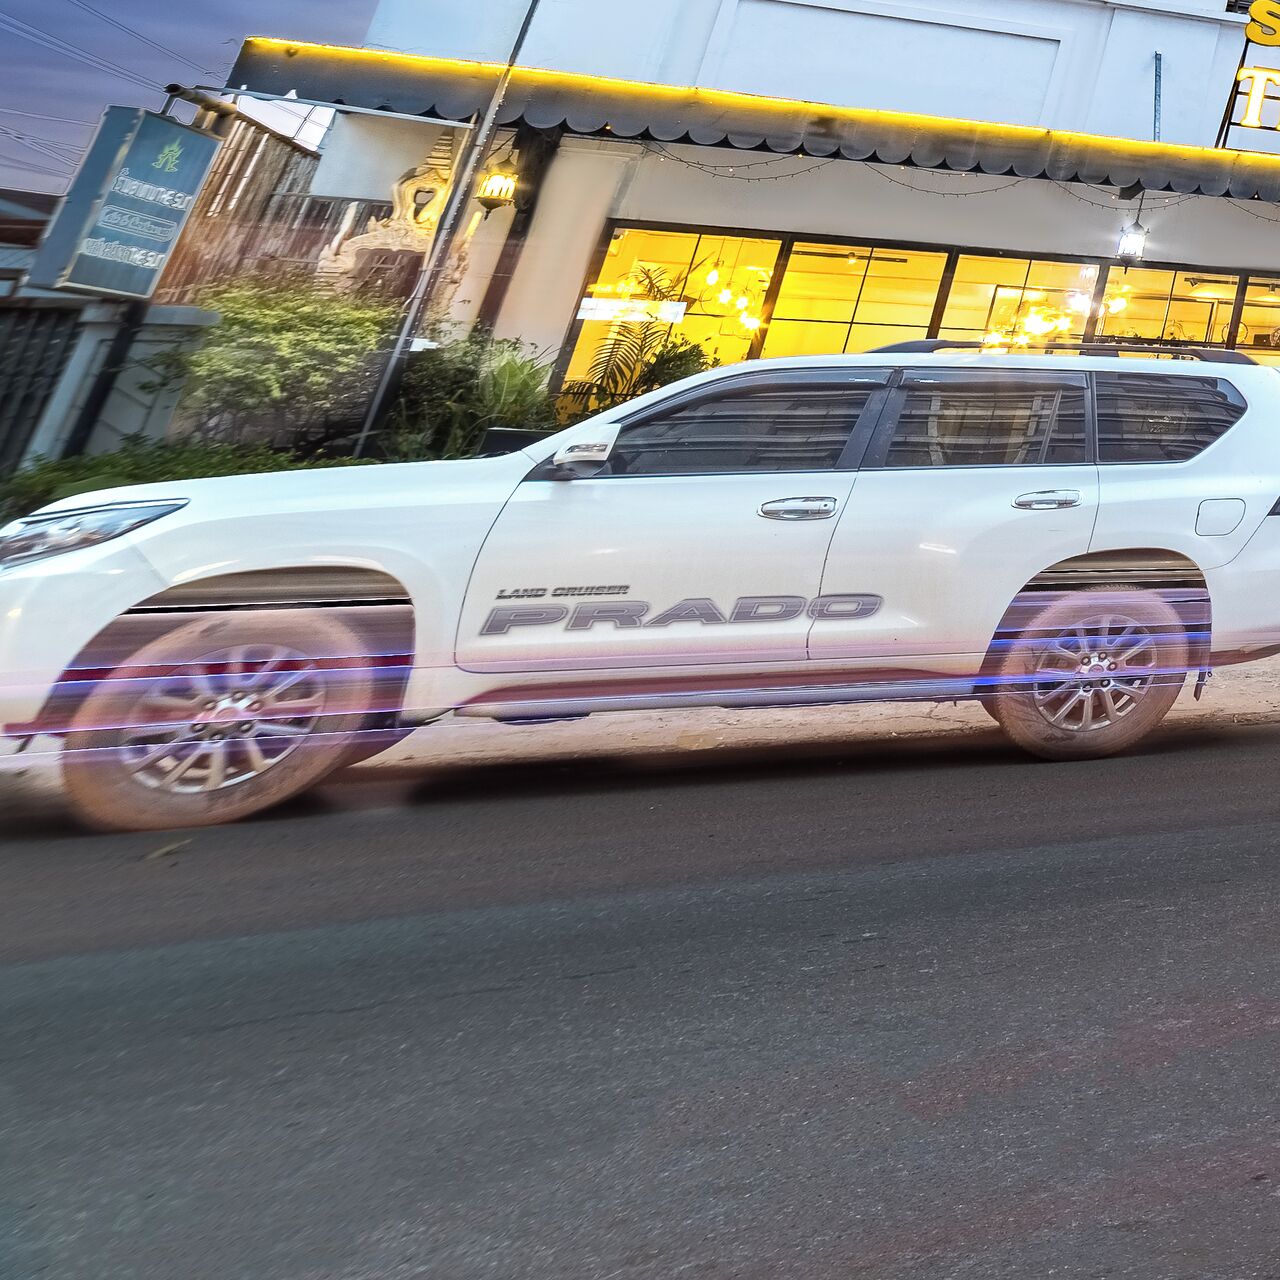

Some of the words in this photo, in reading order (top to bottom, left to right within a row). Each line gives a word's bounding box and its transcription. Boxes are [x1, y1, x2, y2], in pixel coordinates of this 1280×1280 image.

[495, 588, 547, 600] LAND
[551, 584, 630, 597] CRUISER
[479, 593, 884, 636] PRADO
